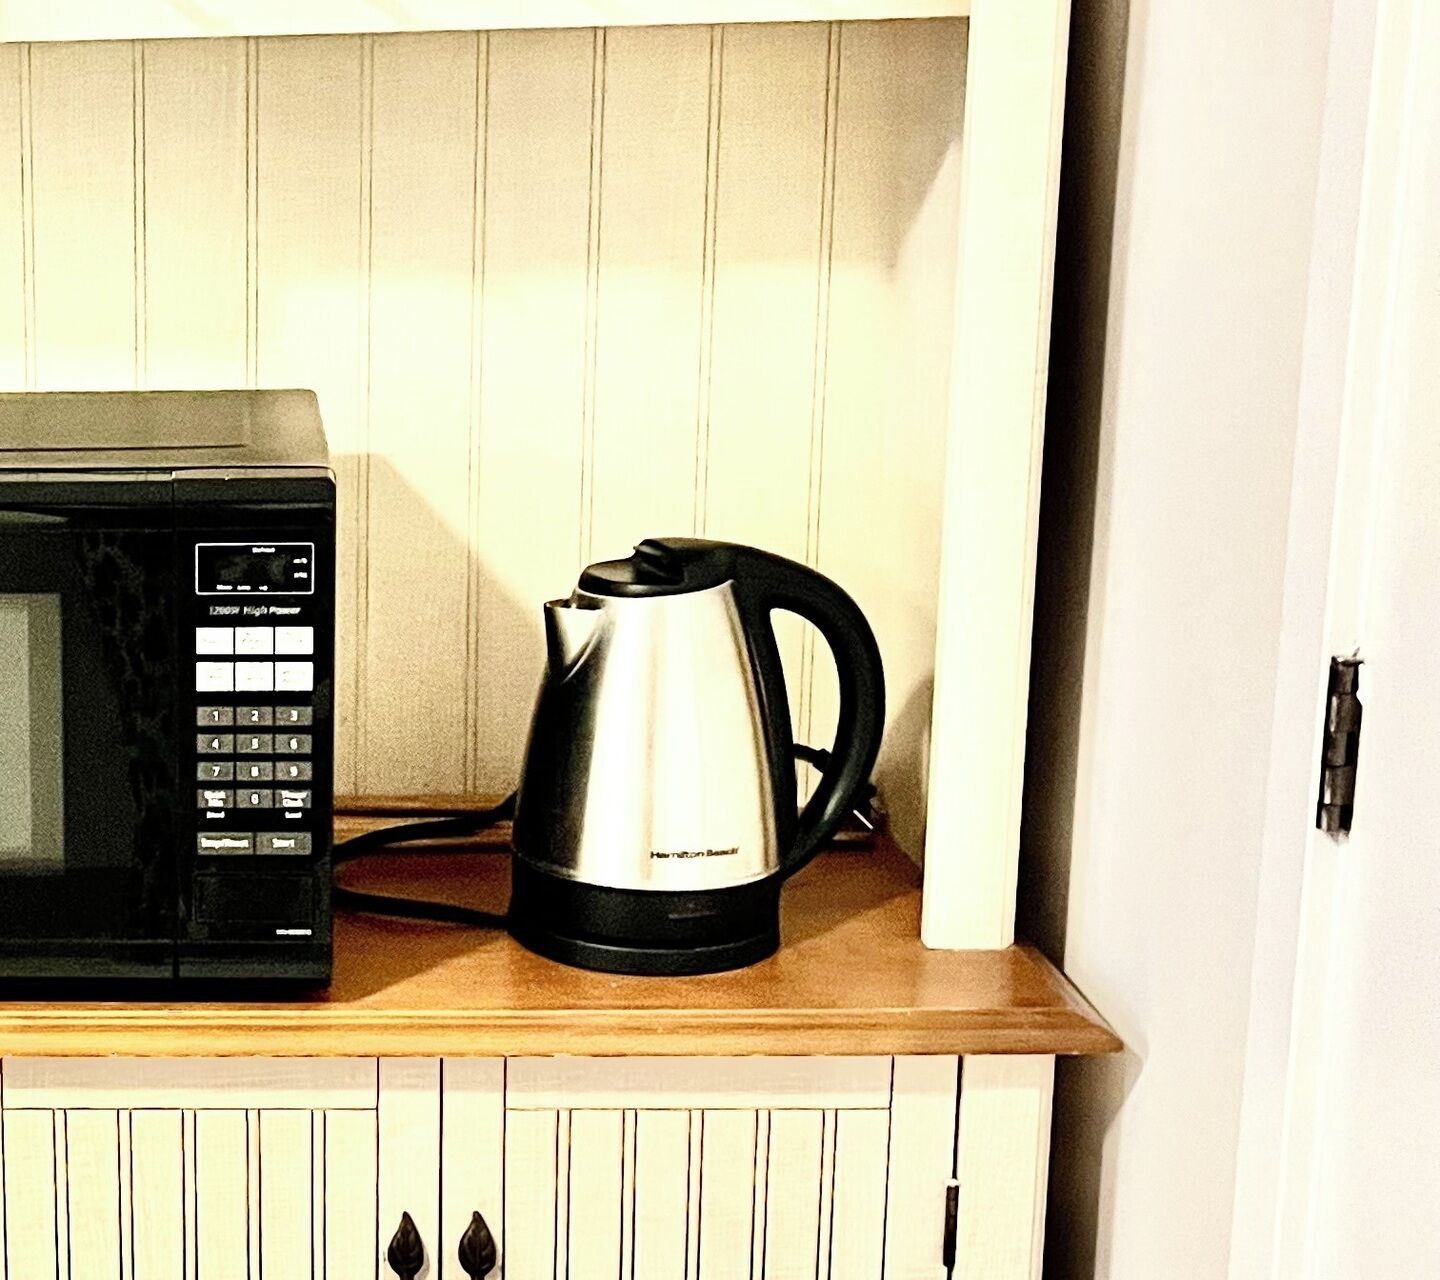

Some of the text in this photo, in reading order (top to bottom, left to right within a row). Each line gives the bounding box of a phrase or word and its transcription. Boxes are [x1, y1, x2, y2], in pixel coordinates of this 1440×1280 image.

[244, 605, 268, 617] High
[213, 710, 219, 722] 1
[251, 710, 259, 722] 2
[290, 709, 298, 722] 3
[212, 738, 219, 750] 4
[212, 765, 220, 777] 7
[290, 765, 298, 777] 9
